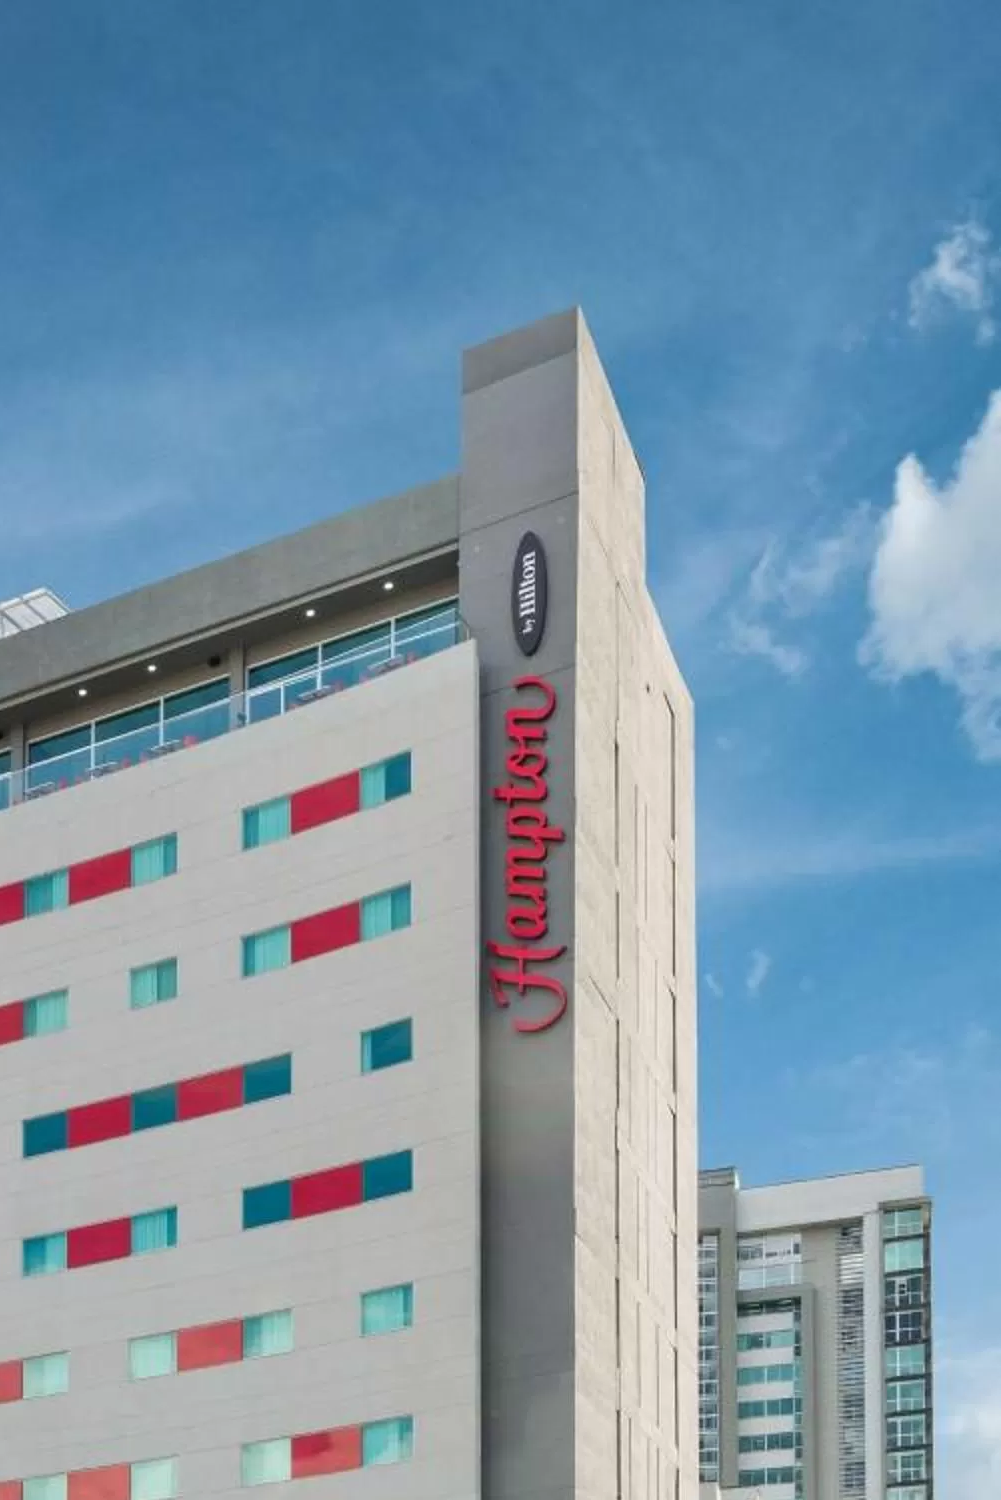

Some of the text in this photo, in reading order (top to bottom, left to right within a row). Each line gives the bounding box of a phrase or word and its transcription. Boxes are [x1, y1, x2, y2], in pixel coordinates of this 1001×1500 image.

[518, 550, 536, 634] by Hilton
[486, 673, 568, 1033] Hampton
